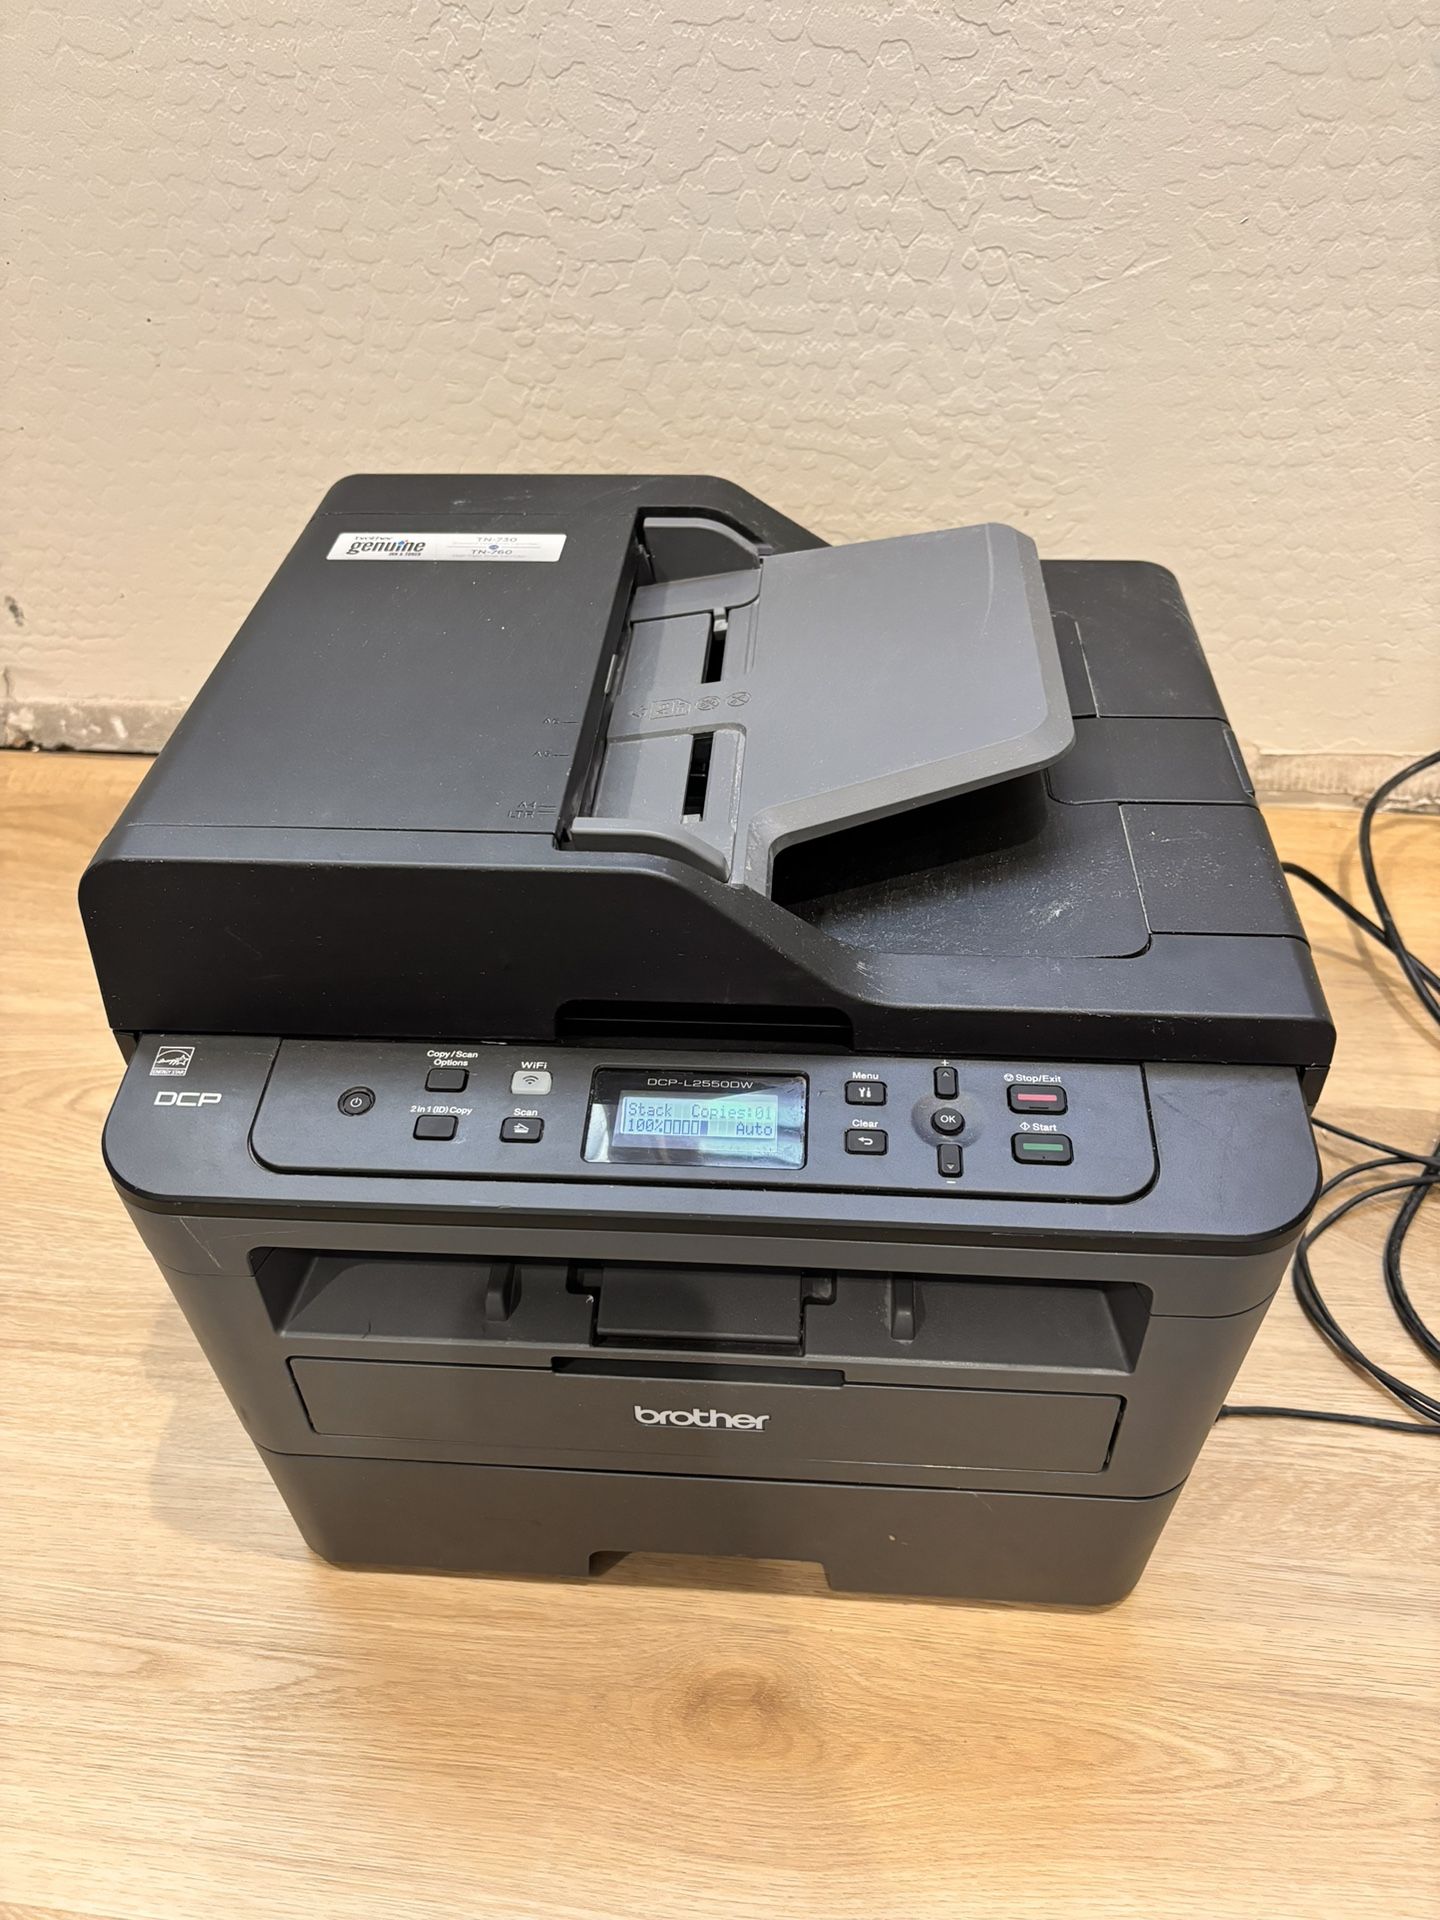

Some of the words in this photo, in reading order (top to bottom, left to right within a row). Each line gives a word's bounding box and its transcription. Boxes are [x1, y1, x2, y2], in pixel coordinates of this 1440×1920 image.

[346, 540, 426, 555] genuine
[518, 801, 537, 809] A4
[508, 810, 535, 818] LTR
[433, 1058, 468, 1067] Options
[521, 1061, 547, 1069] WiFi
[852, 1071, 879, 1080] Menu
[1015, 1074, 1062, 1083] Stop/Exit
[647, 1078, 753, 1089] DCP-L2550DW
[153, 1091, 222, 1107] DCP
[410, 1105, 417, 1113] 2
[417, 1105, 425, 1113] in
[433, 1105, 448, 1114] (ID)
[450, 1107, 472, 1115] Copy
[513, 1108, 538, 1116] Scan
[628, 1102, 672, 1118] Stack
[691, 1104, 772, 1121] Copies:01
[852, 1119, 879, 1128] Clear
[940, 1115, 957, 1123] OK
[736, 1122, 773, 1136] Auto
[1032, 1123, 1057, 1132] Start
[634, 1405, 770, 1430] brother
